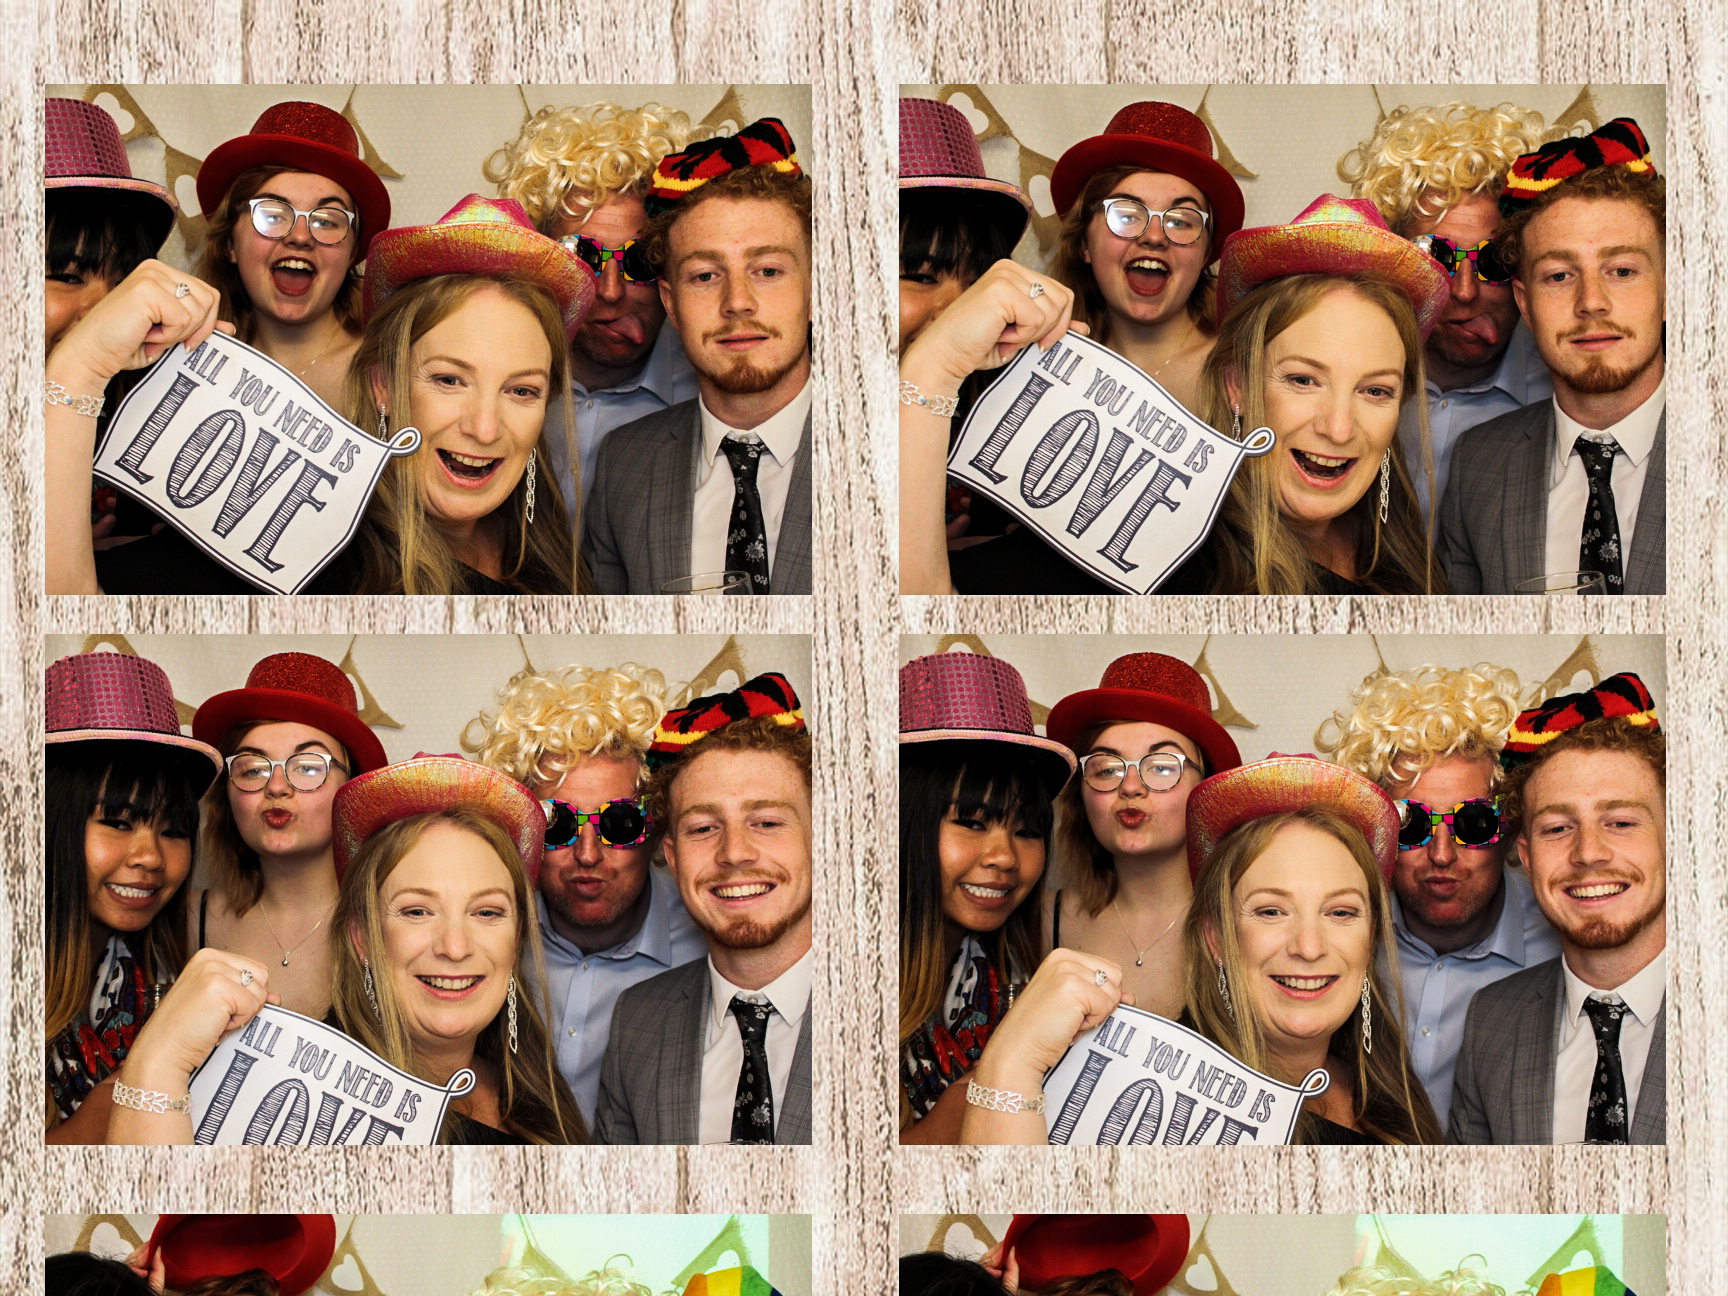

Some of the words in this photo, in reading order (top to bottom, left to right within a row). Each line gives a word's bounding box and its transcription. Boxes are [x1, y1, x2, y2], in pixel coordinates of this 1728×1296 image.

[183, 341, 229, 386] ALL
[229, 367, 280, 416] YOU
[273, 399, 334, 453] NEED
[329, 438, 361, 473] IS
[1037, 341, 1083, 386] ALL
[1083, 367, 1134, 416] YOU
[1127, 399, 1188, 453] NEED
[1183, 438, 1215, 473] IS
[114, 371, 338, 573] LOVE
[968, 371, 1192, 573] LOVE
[194, 1048, 405, 1145] LOV
[239, 1016, 283, 1058] ALL
[288, 1036, 337, 1080] YOU
[335, 1060, 393, 1108] NEED
[394, 1089, 422, 1122] IS
[1048, 1048, 1259, 1145] LOV
[1093, 1016, 1137, 1058] ALL
[1142, 1036, 1191, 1080] YOU
[1189, 1060, 1247, 1108] NEED
[1248, 1089, 1276, 1122] IS
